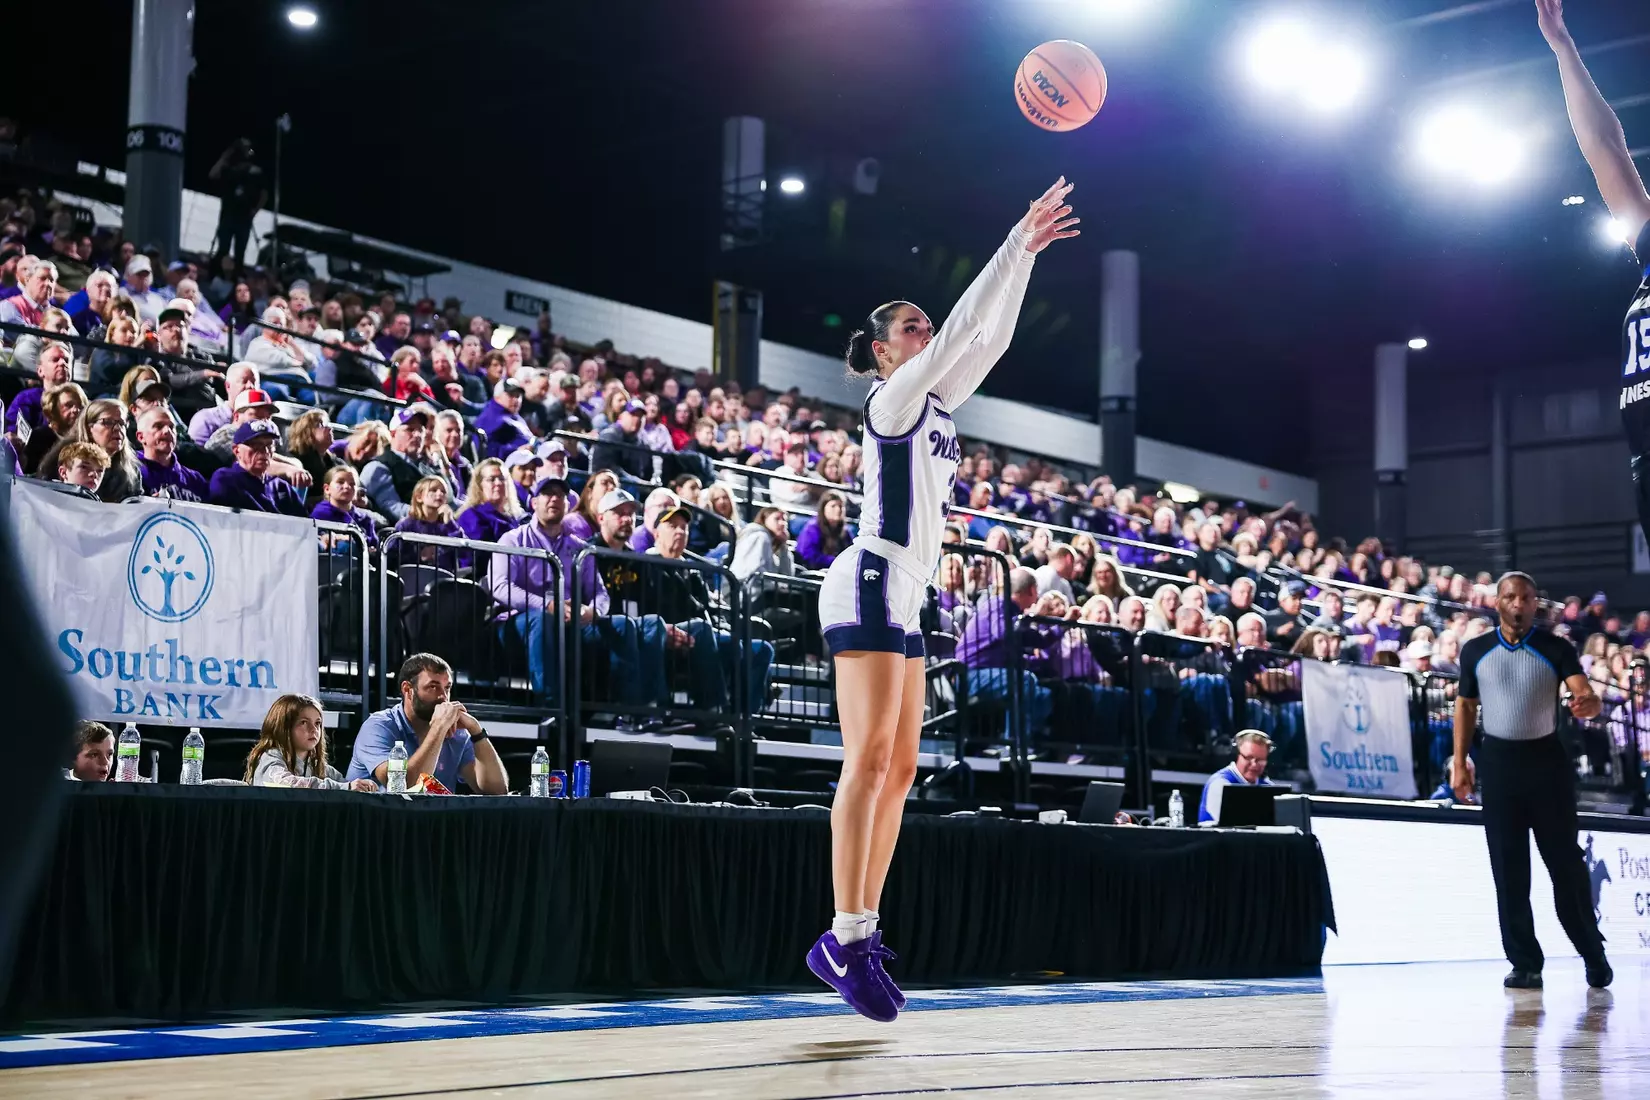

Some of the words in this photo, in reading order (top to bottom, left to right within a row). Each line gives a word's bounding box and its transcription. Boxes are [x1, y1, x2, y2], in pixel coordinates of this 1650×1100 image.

[1032, 69, 1070, 108] NCAA
[57, 628, 278, 689] Southern
[112, 688, 224, 720] BANK
[1320, 741, 1399, 773] Southern
